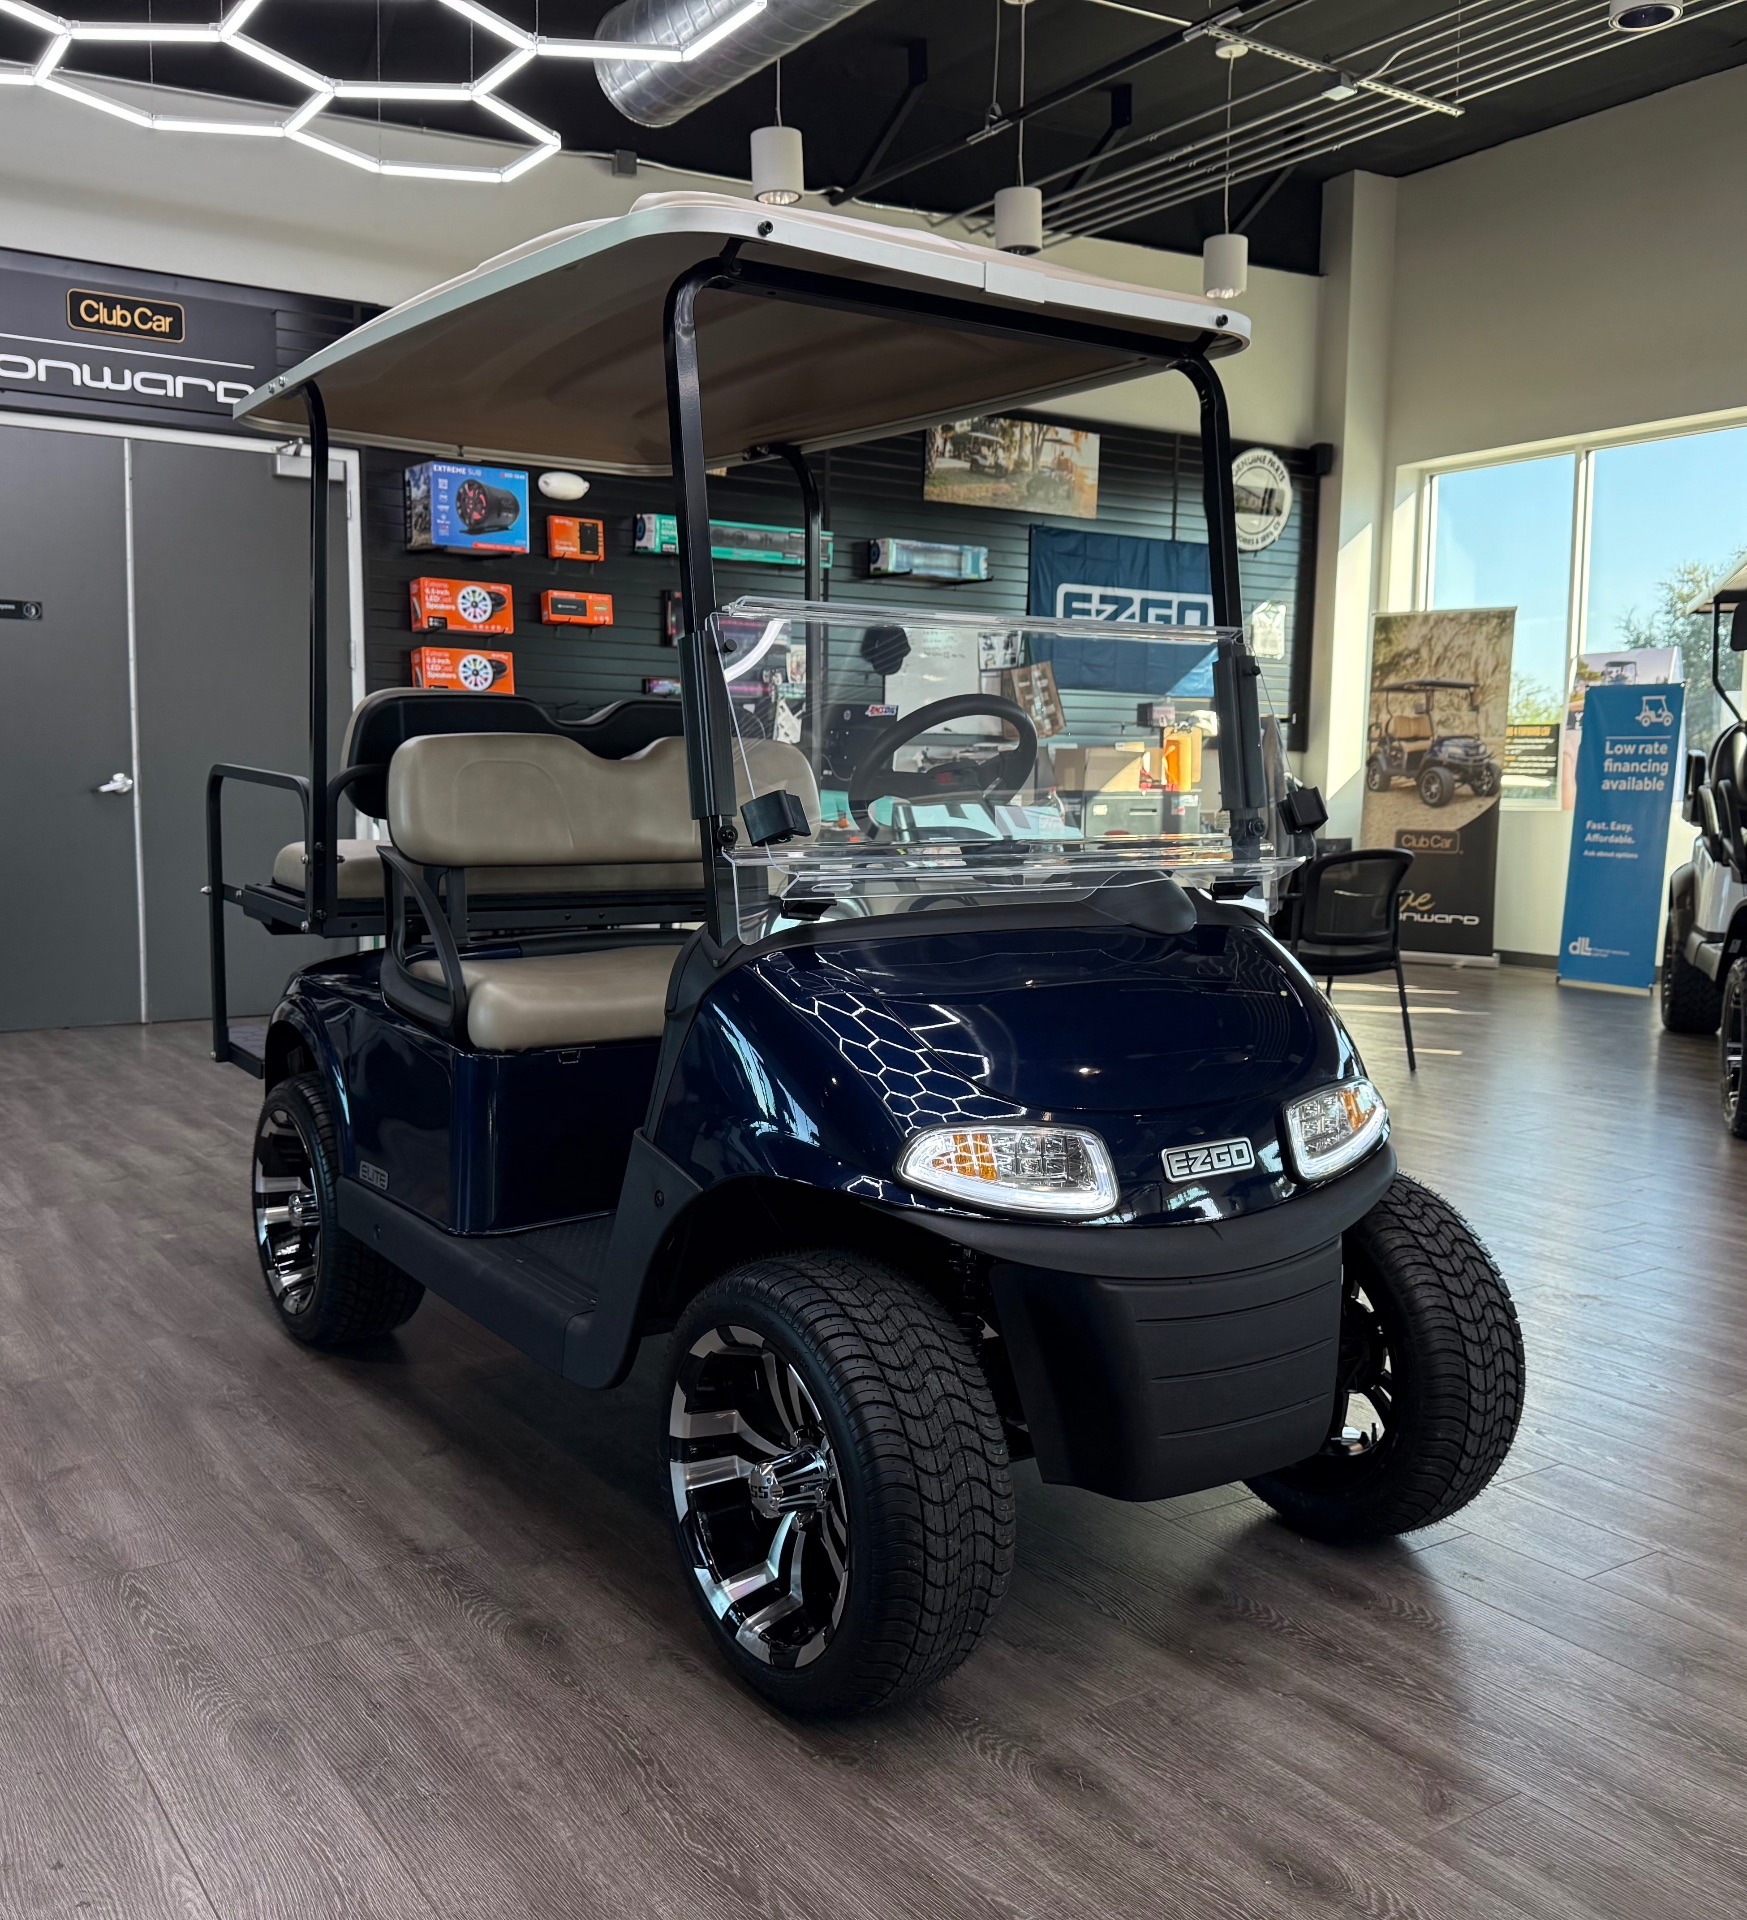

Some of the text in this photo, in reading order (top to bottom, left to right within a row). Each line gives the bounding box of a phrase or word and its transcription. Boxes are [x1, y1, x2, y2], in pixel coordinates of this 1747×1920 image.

[79, 299, 174, 334] Club Car
[432, 463, 467, 475] EXTREME
[1605, 740, 1669, 755] Low rate
[1603, 758, 1669, 777] financing
[1601, 776, 1665, 791] available
[1586, 820, 1633, 833] Fast. Easy.
[1401, 834, 1454, 849] Club Car
[1584, 833, 1635, 844] Affordable.
[1398, 911, 1480, 926] nward
[1168, 1143, 1251, 1175] EZGO
